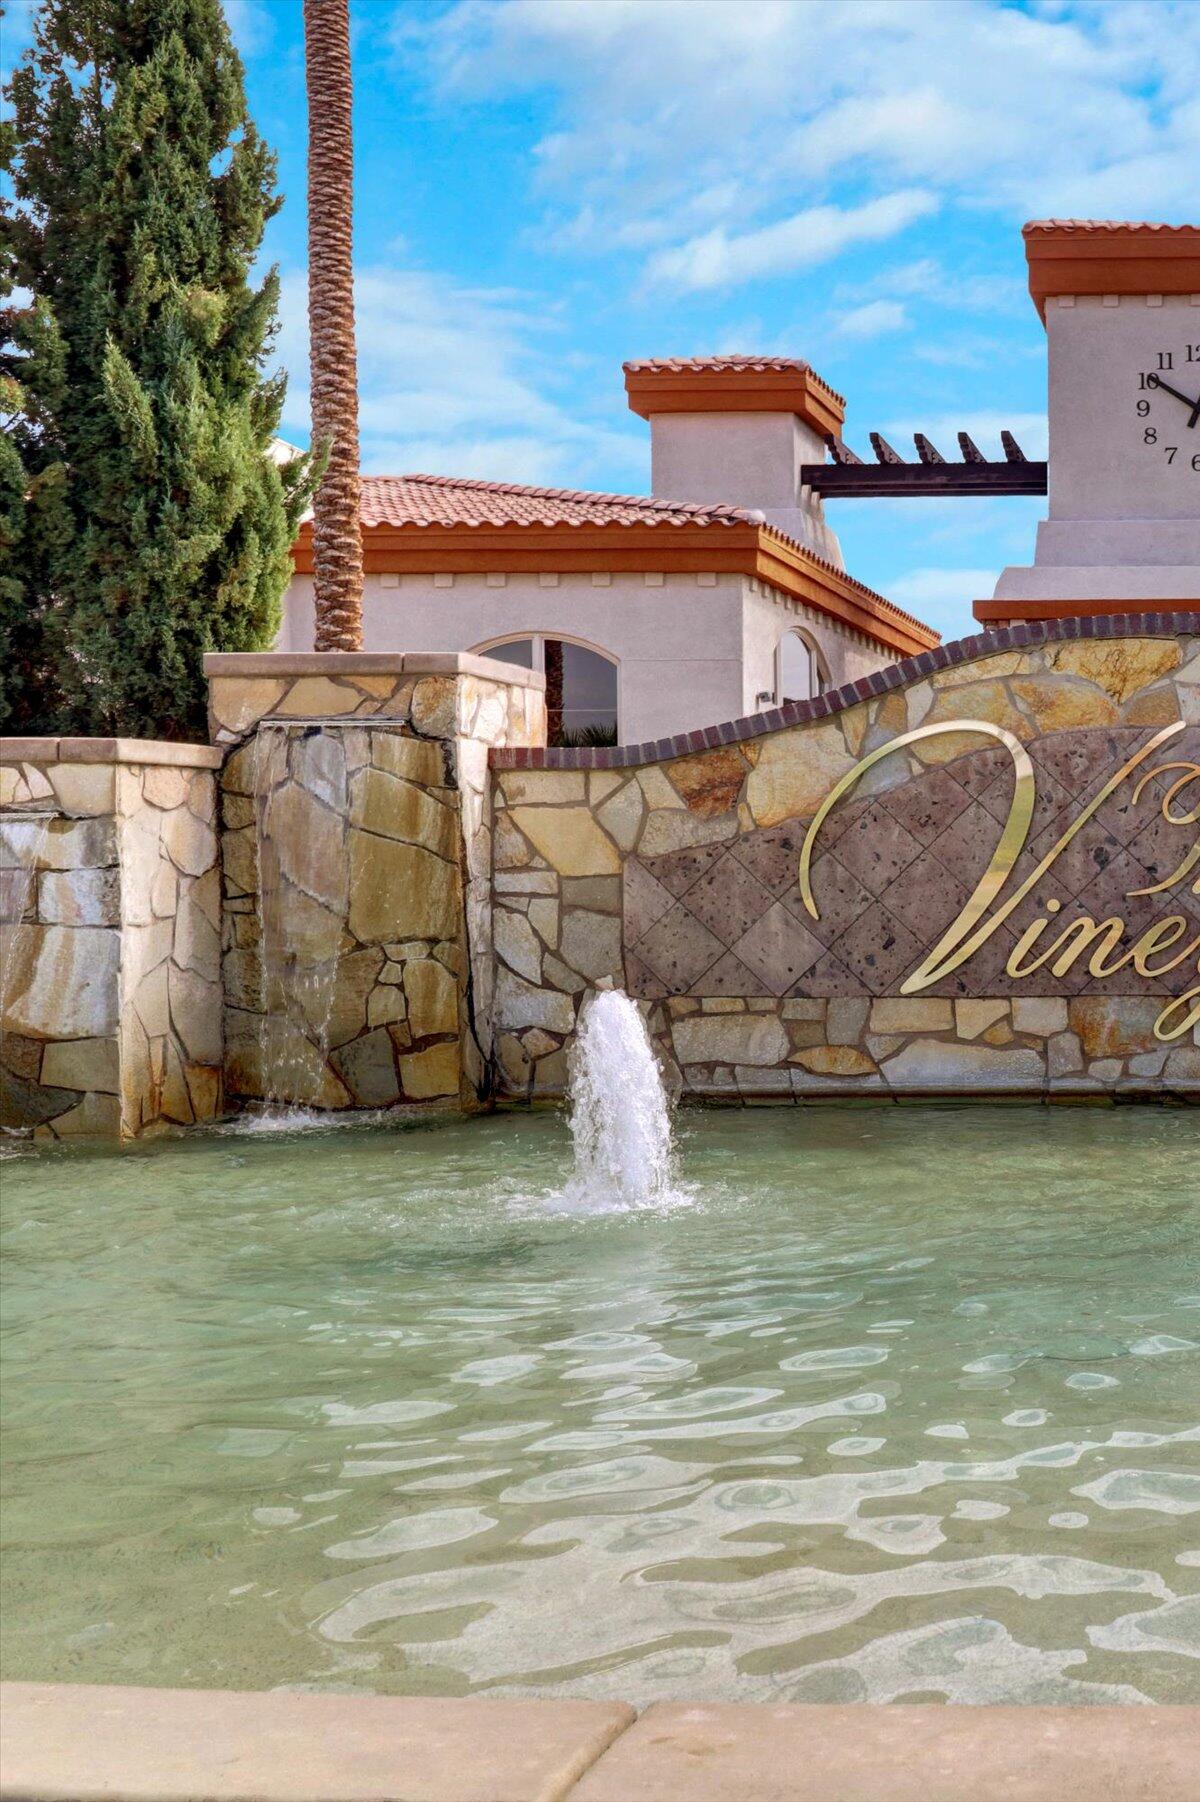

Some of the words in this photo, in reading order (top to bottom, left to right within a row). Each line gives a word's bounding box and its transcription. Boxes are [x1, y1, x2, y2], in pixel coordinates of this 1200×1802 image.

[1157, 352, 1174, 370] 11
[1138, 372, 1160, 390] 10
[1136, 400, 1150, 417] 9
[1144, 427, 1157, 445] 8
[1164, 447, 1178, 465] 7
